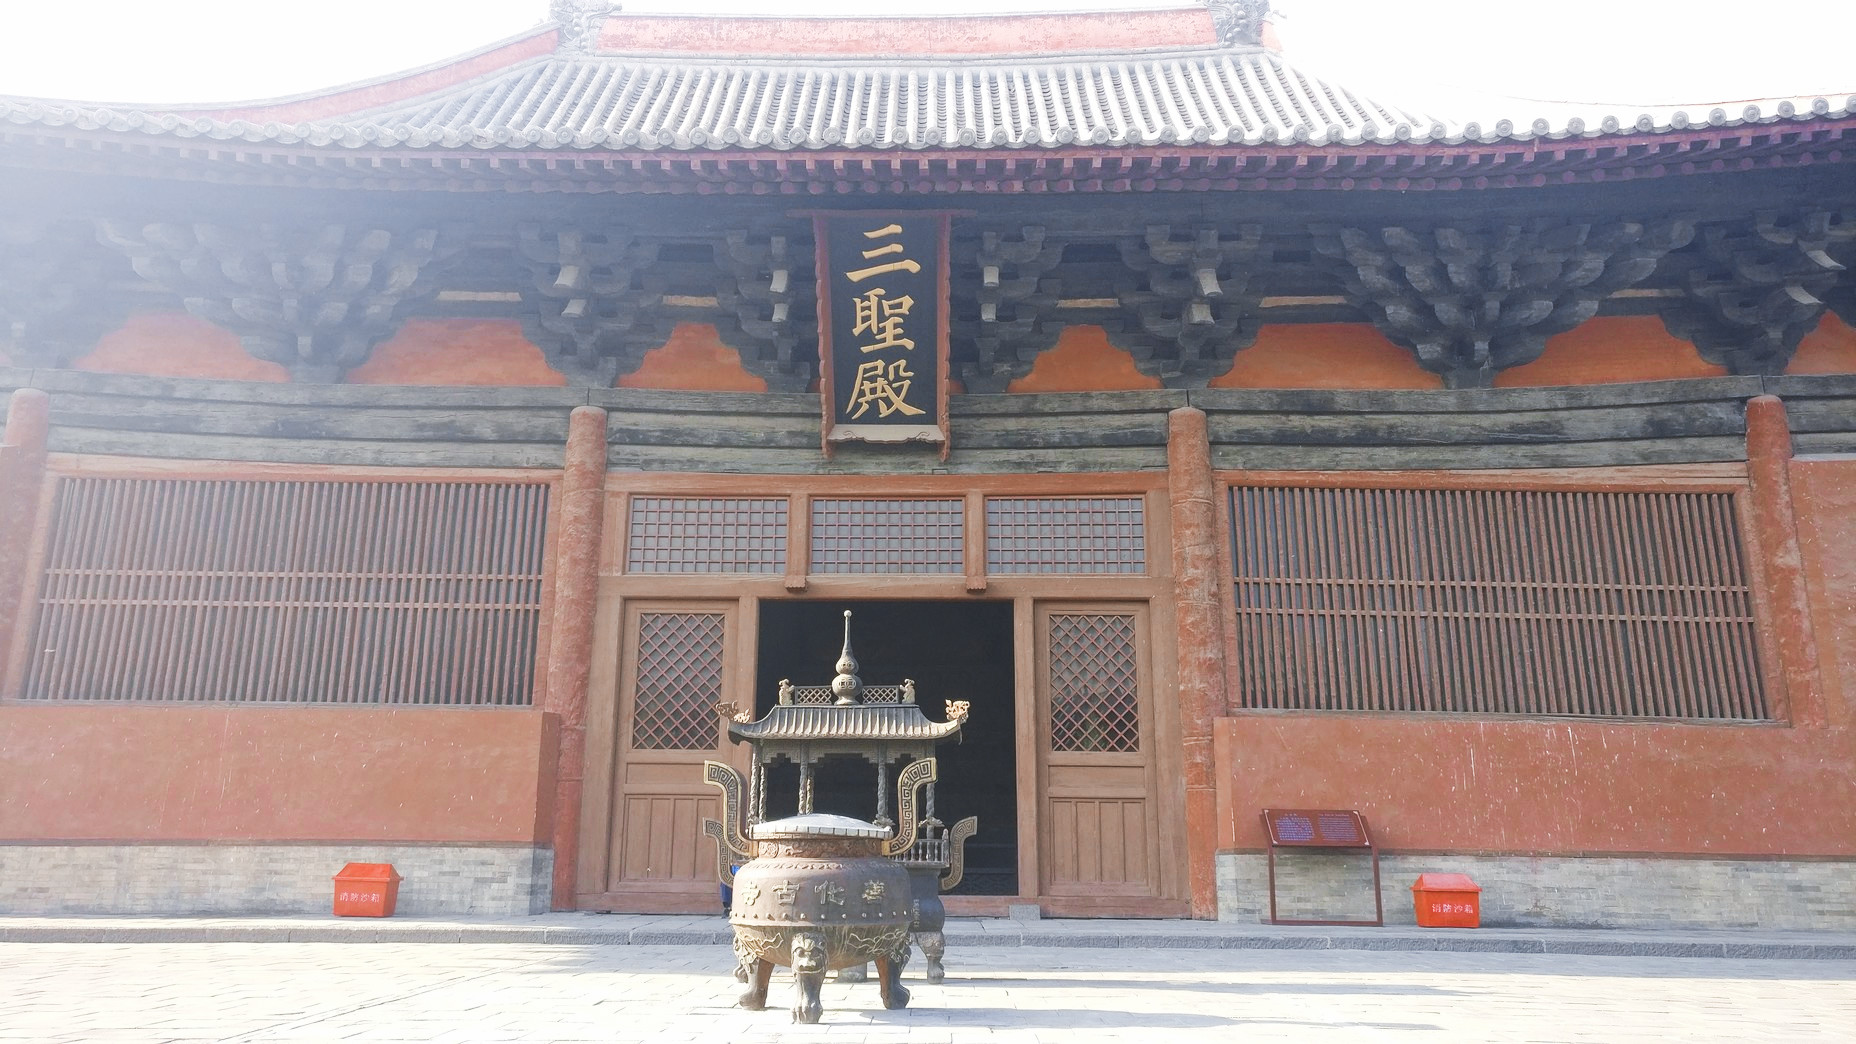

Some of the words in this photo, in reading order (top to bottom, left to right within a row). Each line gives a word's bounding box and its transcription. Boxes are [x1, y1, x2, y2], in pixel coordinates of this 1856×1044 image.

[845, 224, 927, 420] 三聖殿
[1431, 903, 1474, 914] 消防沙箱
